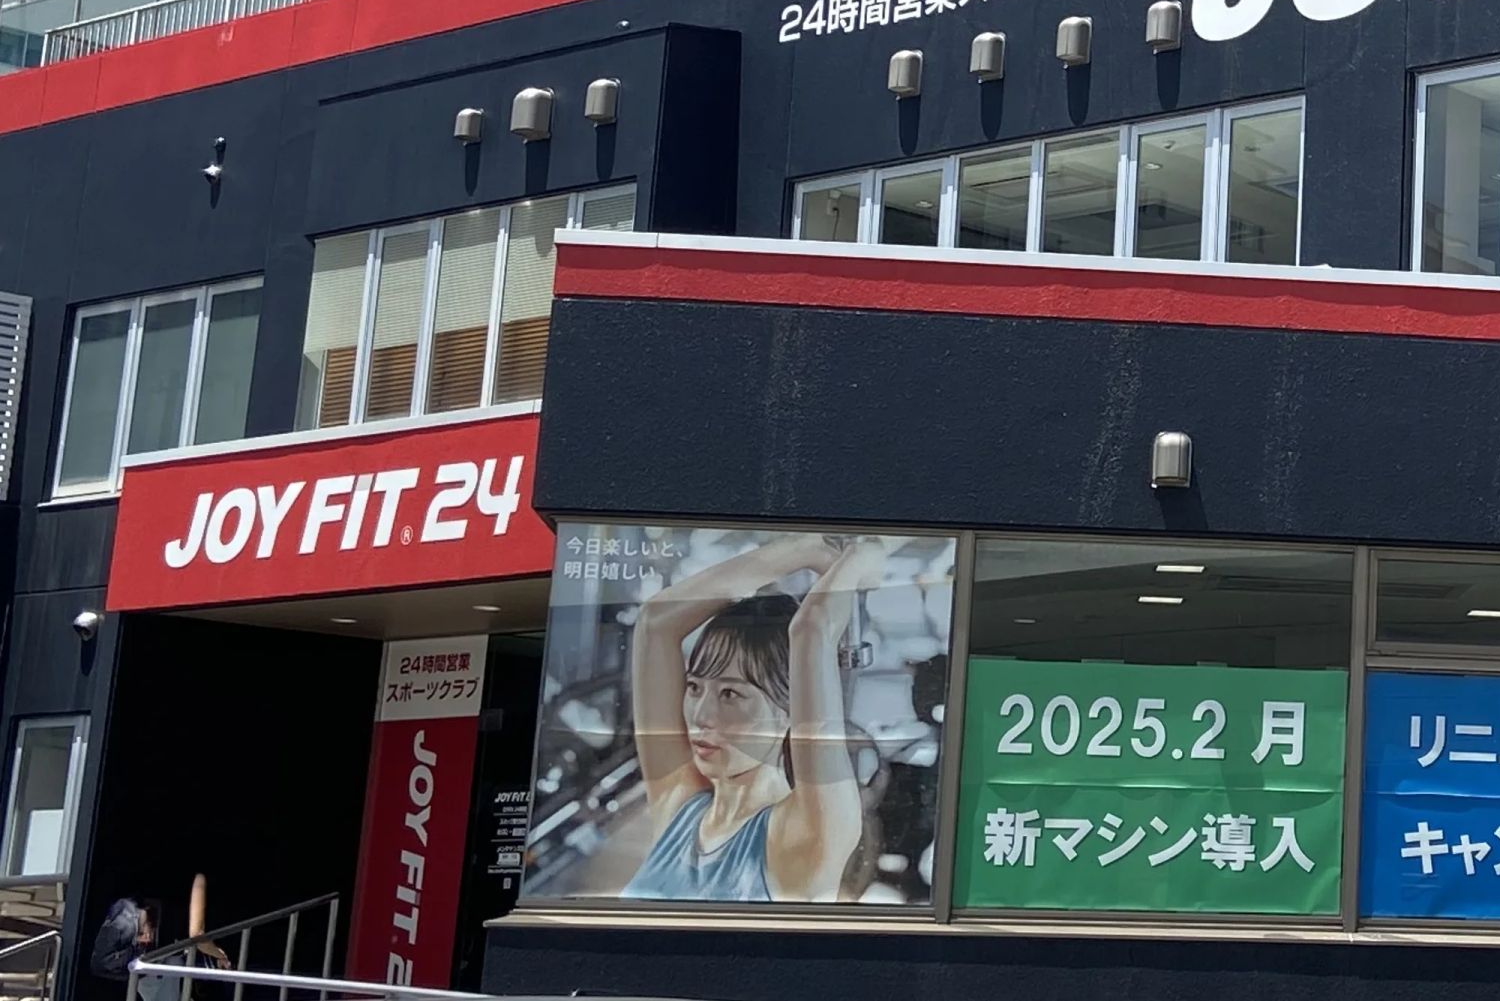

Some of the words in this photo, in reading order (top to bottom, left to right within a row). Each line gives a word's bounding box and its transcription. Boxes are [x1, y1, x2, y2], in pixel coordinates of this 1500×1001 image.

[421, 456, 524, 542] 24
[566, 536, 682, 558] 今日楽しいと、
[564, 561, 655, 580] 明日嬉しい
[400, 653, 471, 674] 24時間営業
[386, 677, 480, 702] スポーツクラブ
[983, 808, 1316, 873] 新マシン導入
